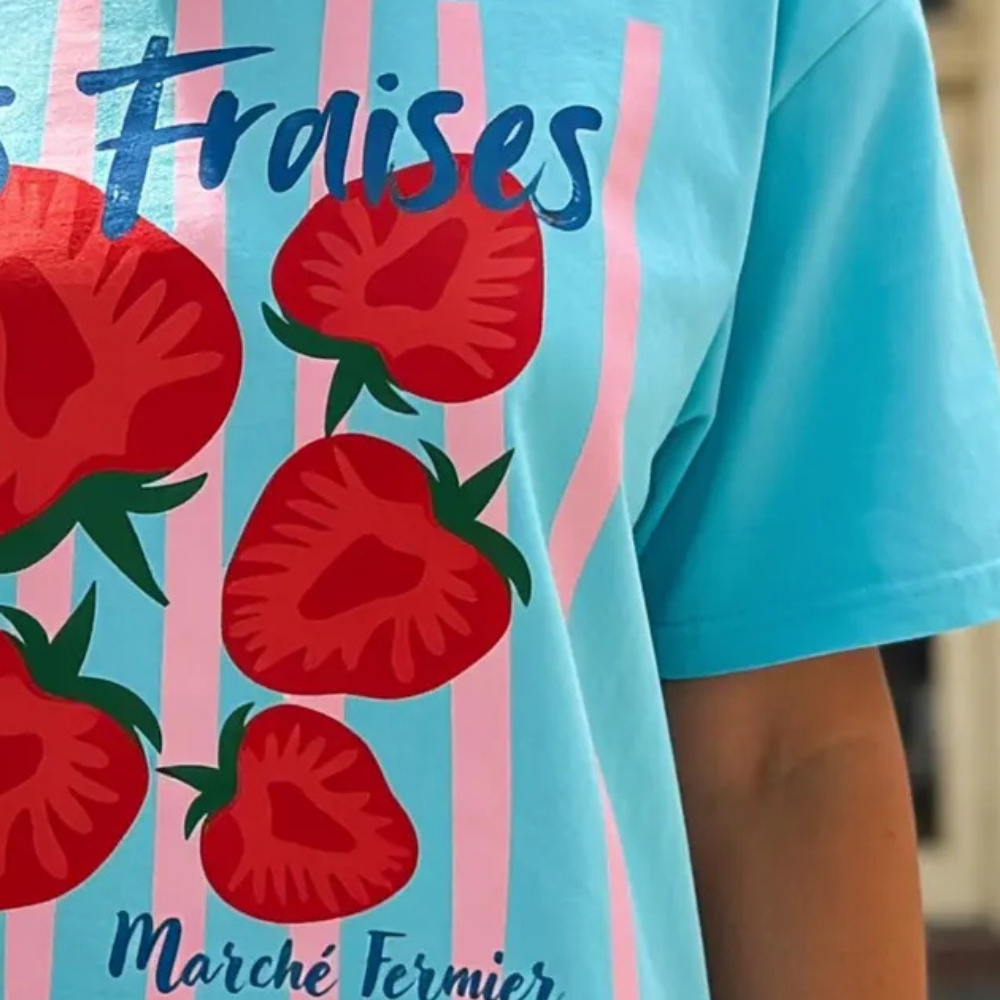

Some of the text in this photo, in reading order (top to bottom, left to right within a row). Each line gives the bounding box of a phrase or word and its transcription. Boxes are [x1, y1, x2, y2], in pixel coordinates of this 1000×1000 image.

[76, 35, 603, 240] Fraises
[107, 910, 565, 1000] Marché Fermier
